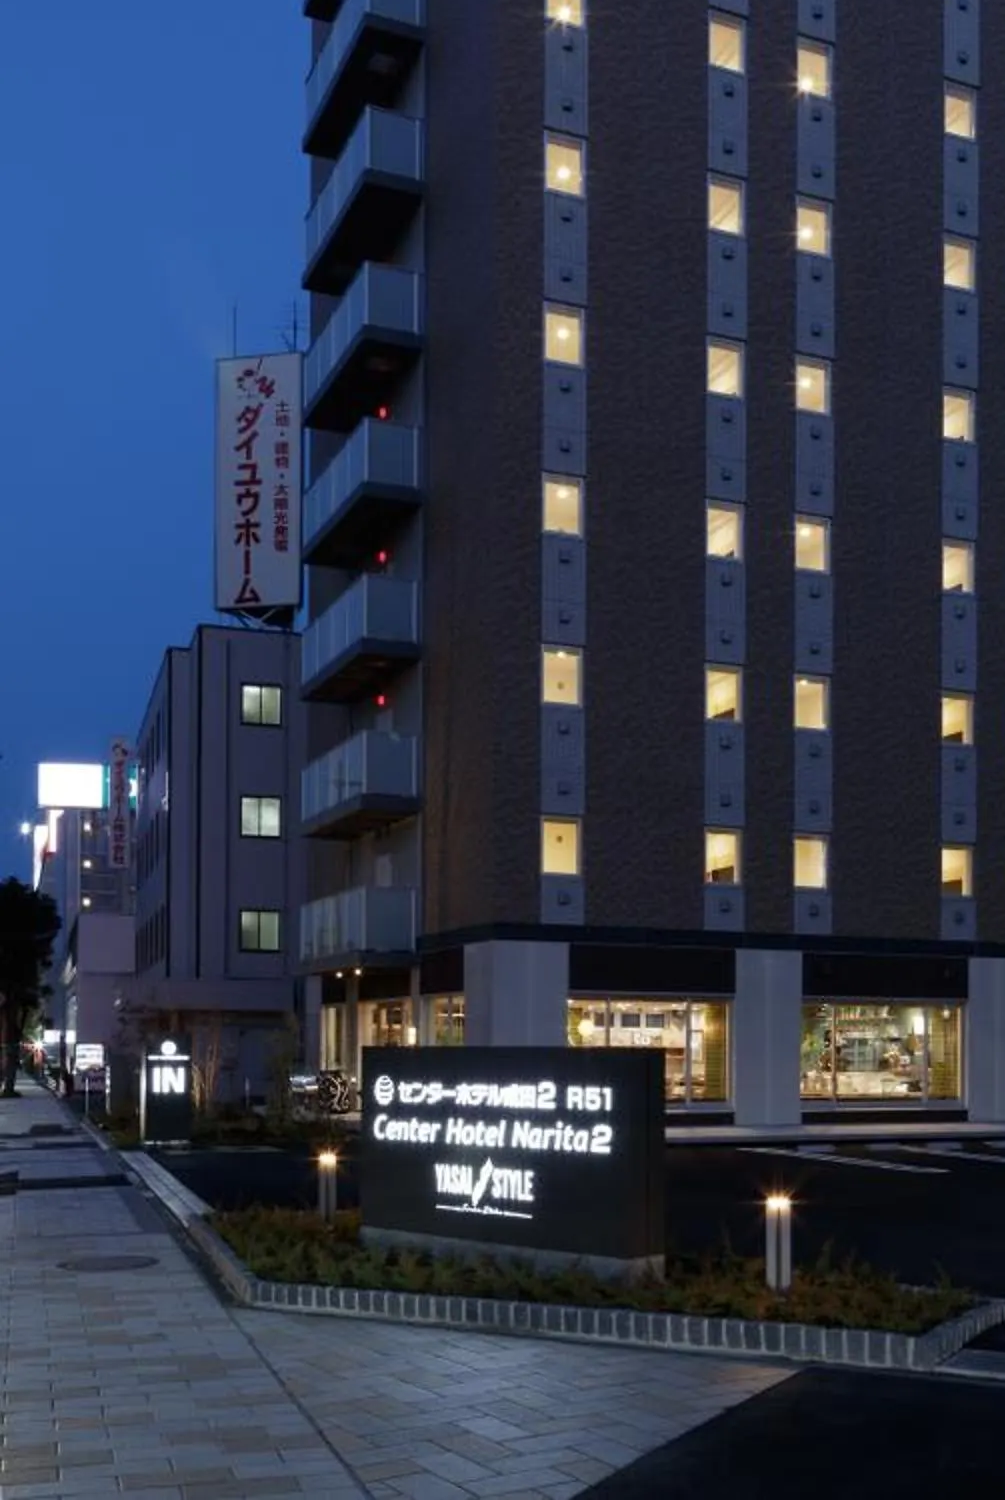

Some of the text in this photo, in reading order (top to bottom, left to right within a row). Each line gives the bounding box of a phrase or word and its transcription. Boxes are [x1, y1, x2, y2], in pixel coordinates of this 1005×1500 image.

[234, 402, 263, 604] ダイユウホーム
[152, 1066, 186, 1094] IN
[566, 1085, 613, 1112] R51
[373, 1113, 441, 1144] Center
[445, 1117, 507, 1148] Hotel
[491, 1167, 535, 1201] STYLE
